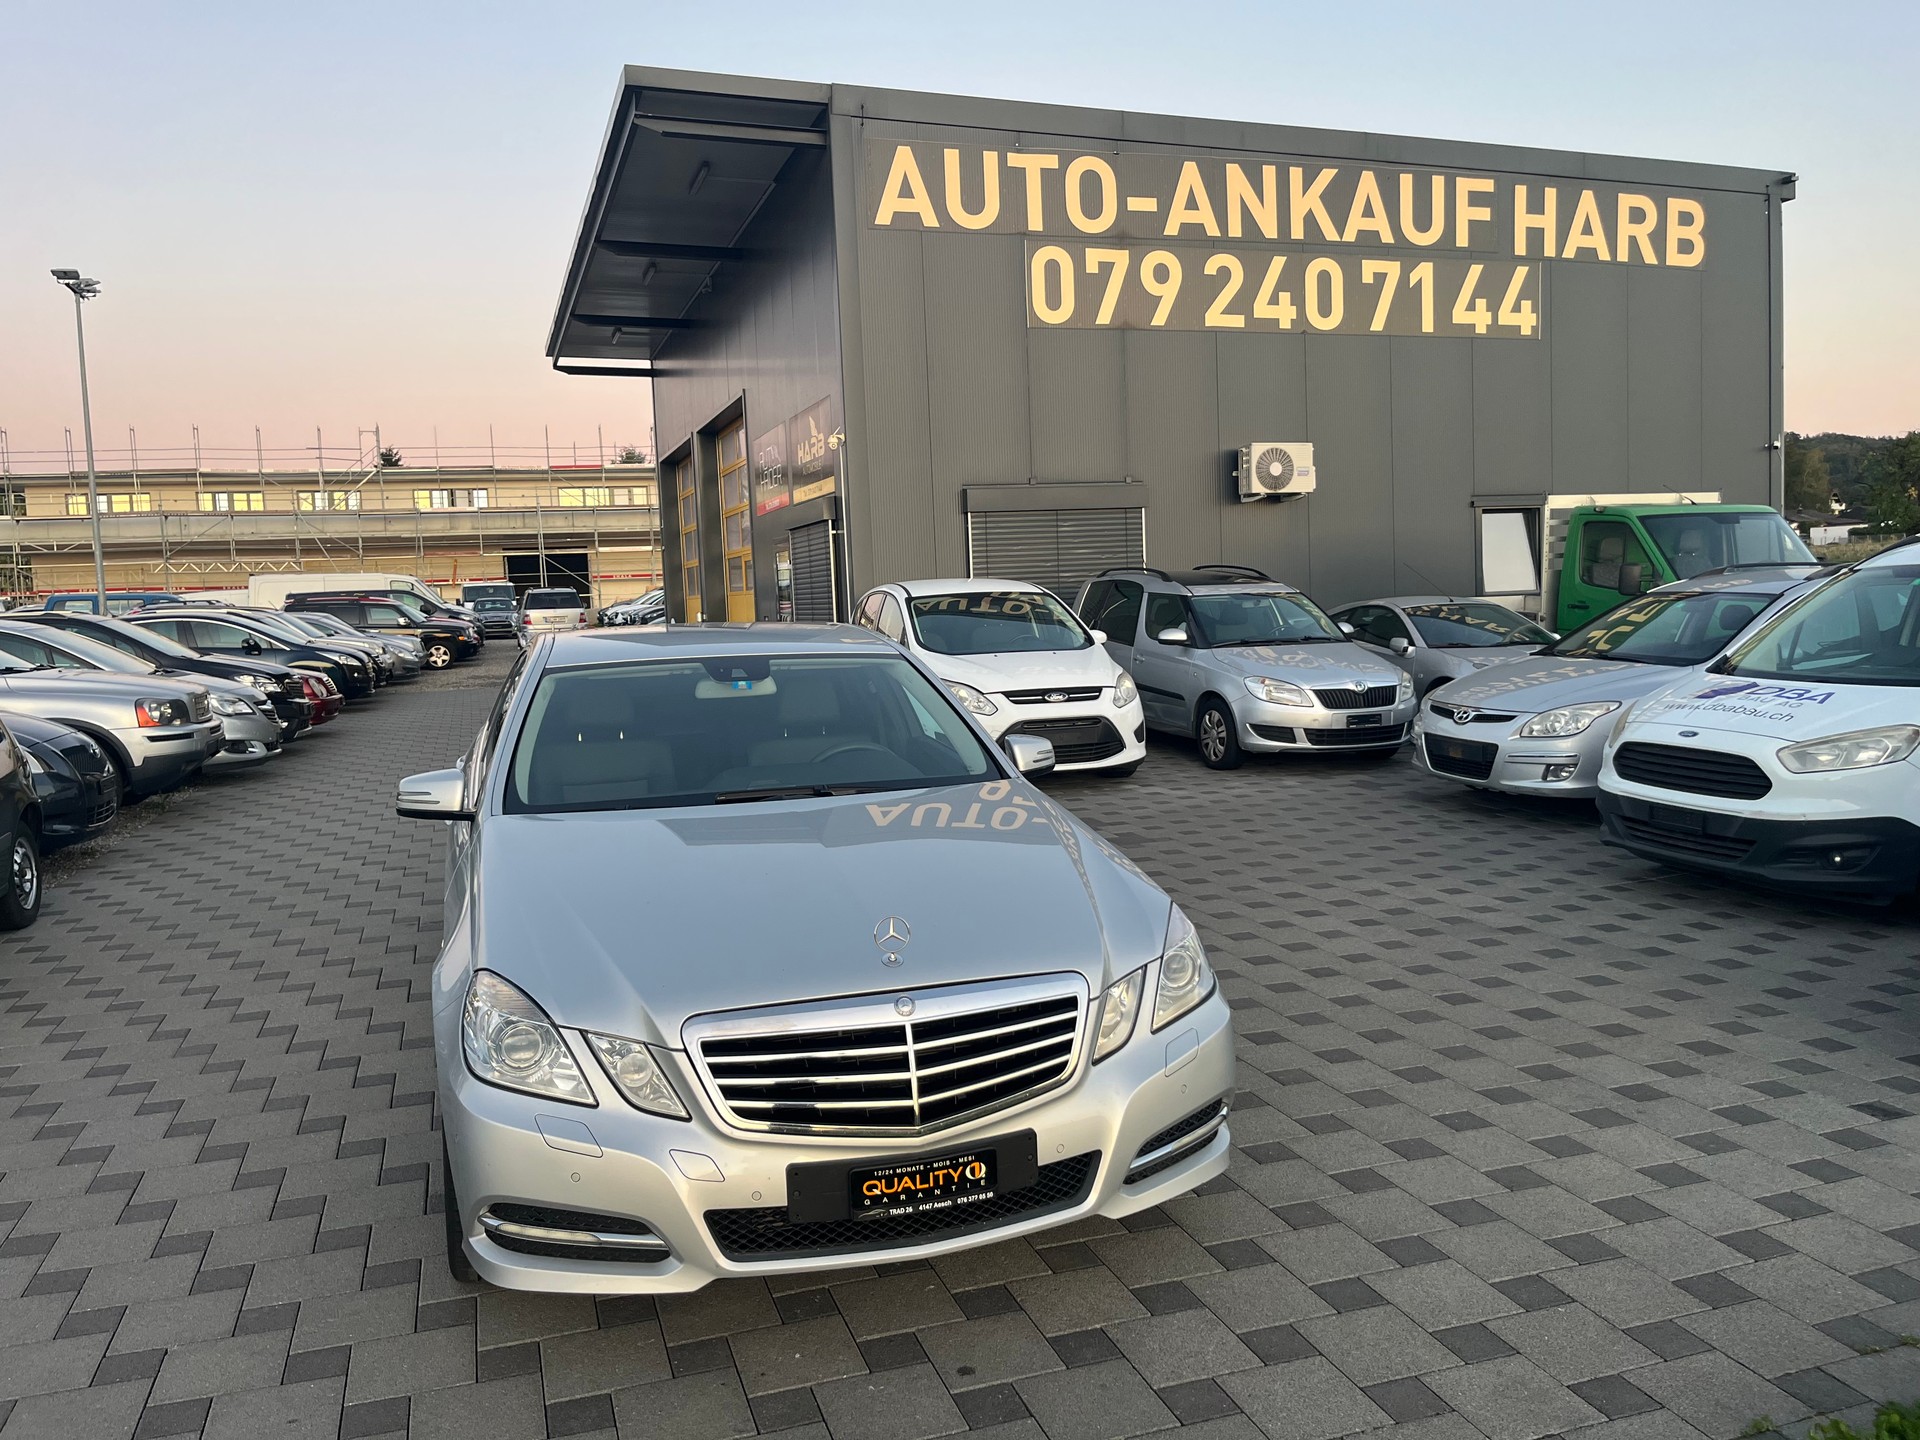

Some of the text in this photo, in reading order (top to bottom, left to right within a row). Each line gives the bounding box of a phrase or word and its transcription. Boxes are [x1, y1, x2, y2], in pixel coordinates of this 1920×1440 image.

[875, 146, 1705, 268] AUTO-ANKAUF HARB
[1031, 246, 1537, 335] 079 240 71 44
[797, 432, 825, 465] HARB
[1746, 686, 1836, 704] DBA
[1779, 700, 1804, 709] AG
[1664, 701, 1795, 723] www.dbabau.ch
[874, 1168, 893, 1176] 12/24
[896, 1165, 924, 1173] MONATE
[933, 1160, 951, 1168] MOIS
[958, 1155, 975, 1163] MESI
[863, 1166, 963, 1196] QUALITY
[864, 1179, 985, 1206] GARANTIE
[889, 1207, 905, 1216] TRAD
[918, 1202, 933, 1211] 4147
[933, 1199, 952, 1209] Aesch
